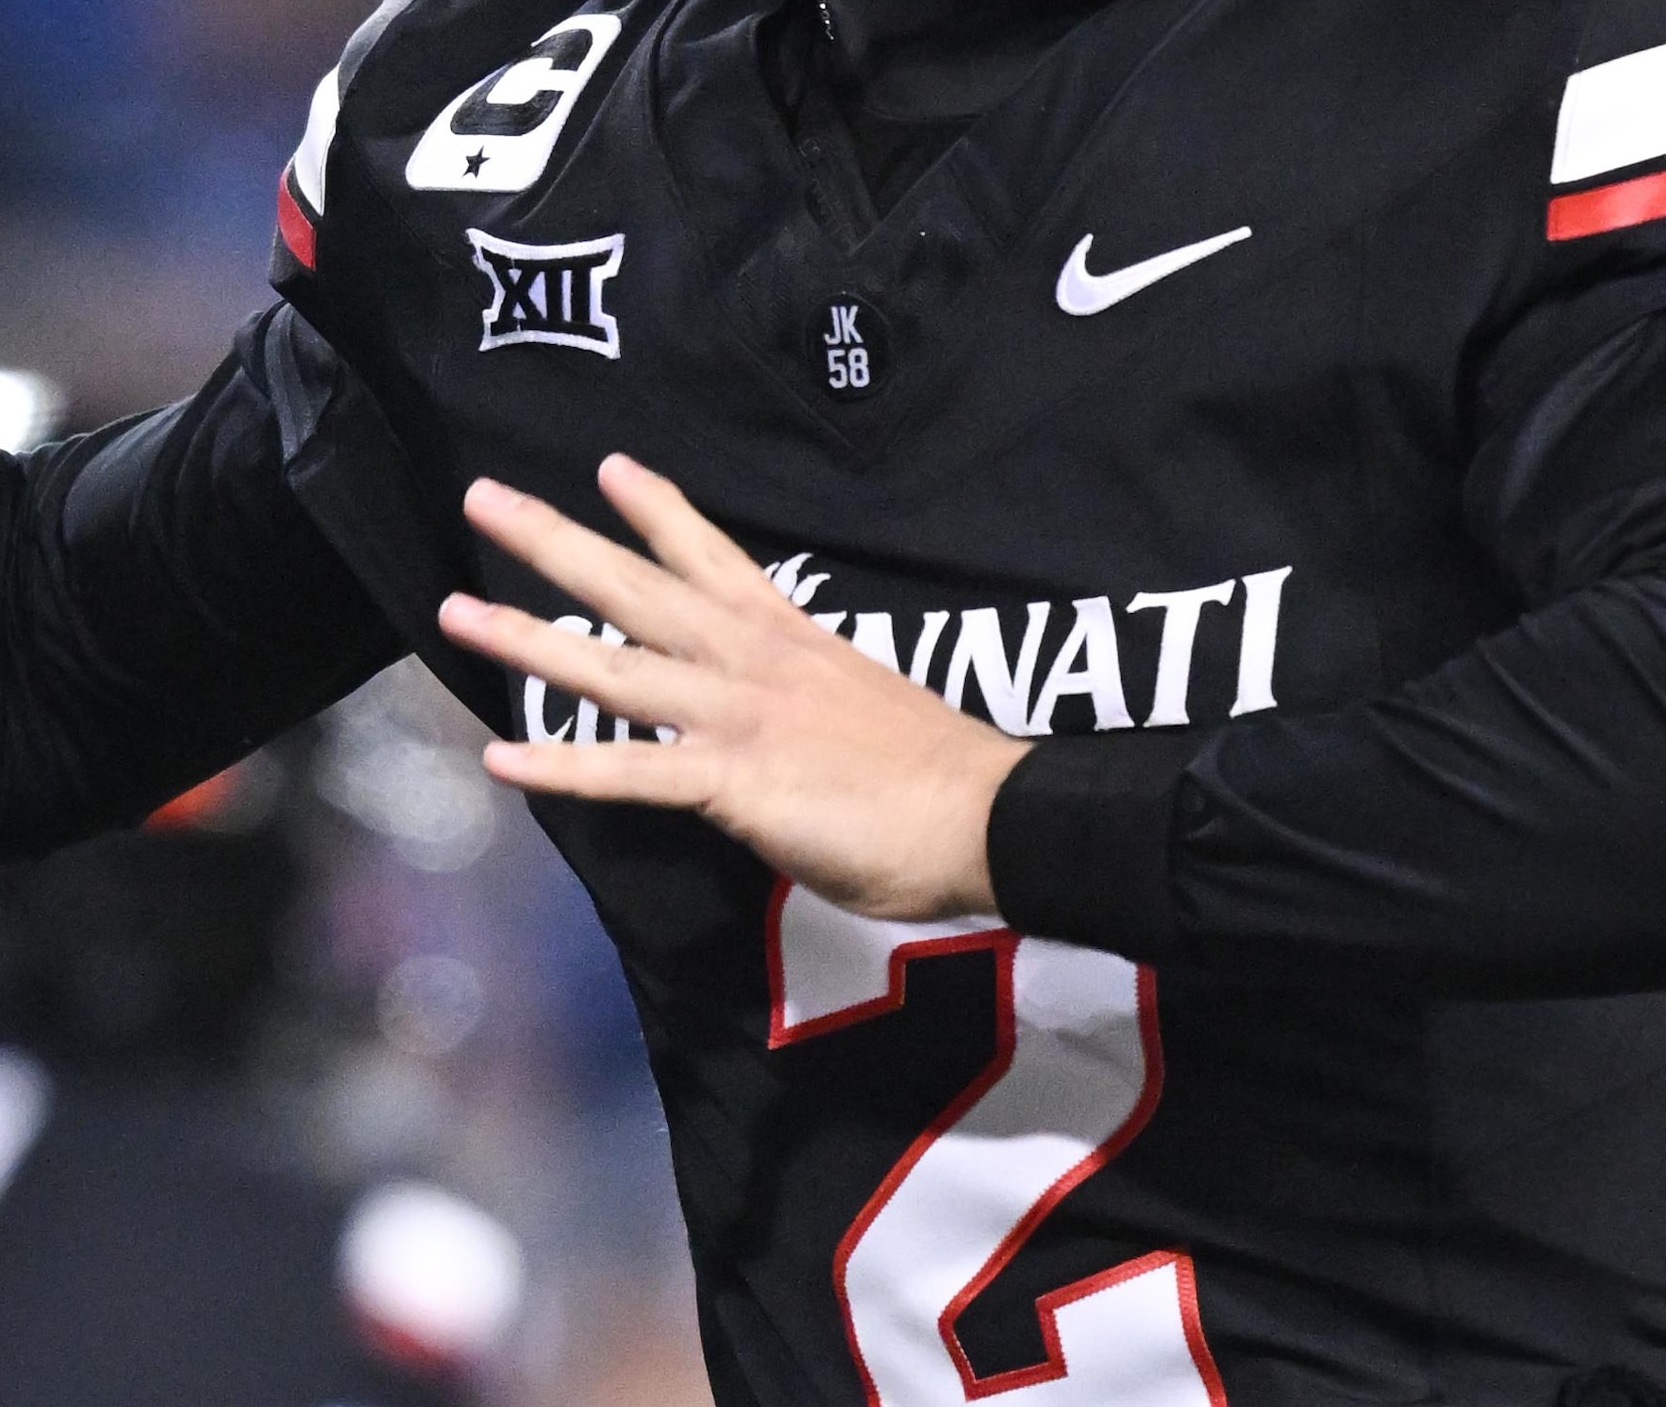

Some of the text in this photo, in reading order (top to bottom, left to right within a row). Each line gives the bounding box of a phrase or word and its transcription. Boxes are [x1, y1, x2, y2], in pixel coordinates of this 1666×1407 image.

[450, 28, 594, 136] C
[479, 246, 614, 343] XII
[823, 304, 865, 345] JK
[826, 347, 871, 389] 58
[765, 877, 1231, 1407] 2
